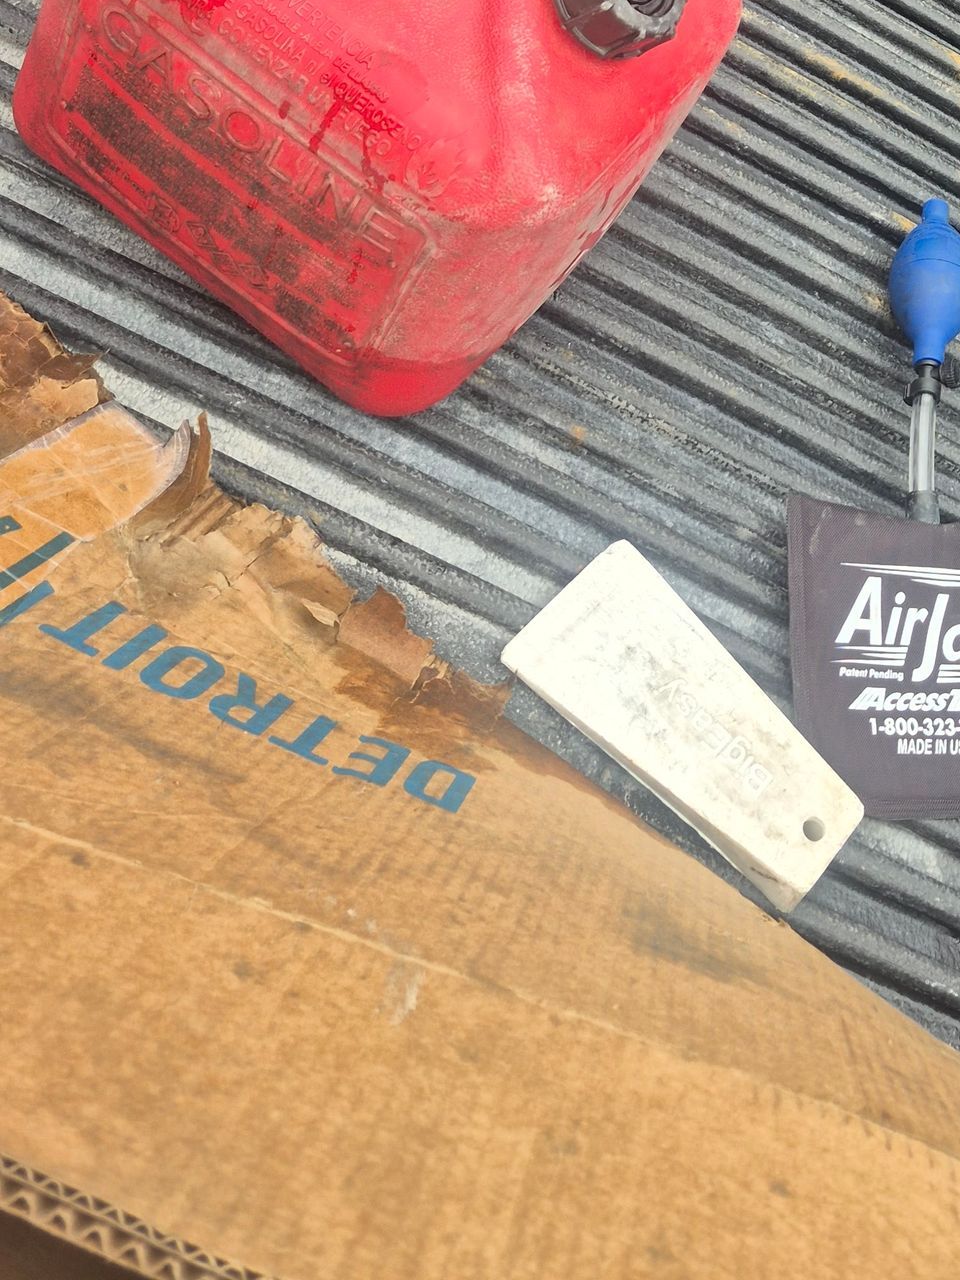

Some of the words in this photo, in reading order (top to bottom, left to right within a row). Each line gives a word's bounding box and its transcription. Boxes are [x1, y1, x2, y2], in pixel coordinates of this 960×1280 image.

[94, 5, 406, 258] GASOLINE
[38, 600, 477, 814] DETROIT
[839, 667, 867, 678] Patent
[869, 668, 904, 681] Pending
[897, 739, 932, 755] MADE
[935, 739, 948, 755] IN
